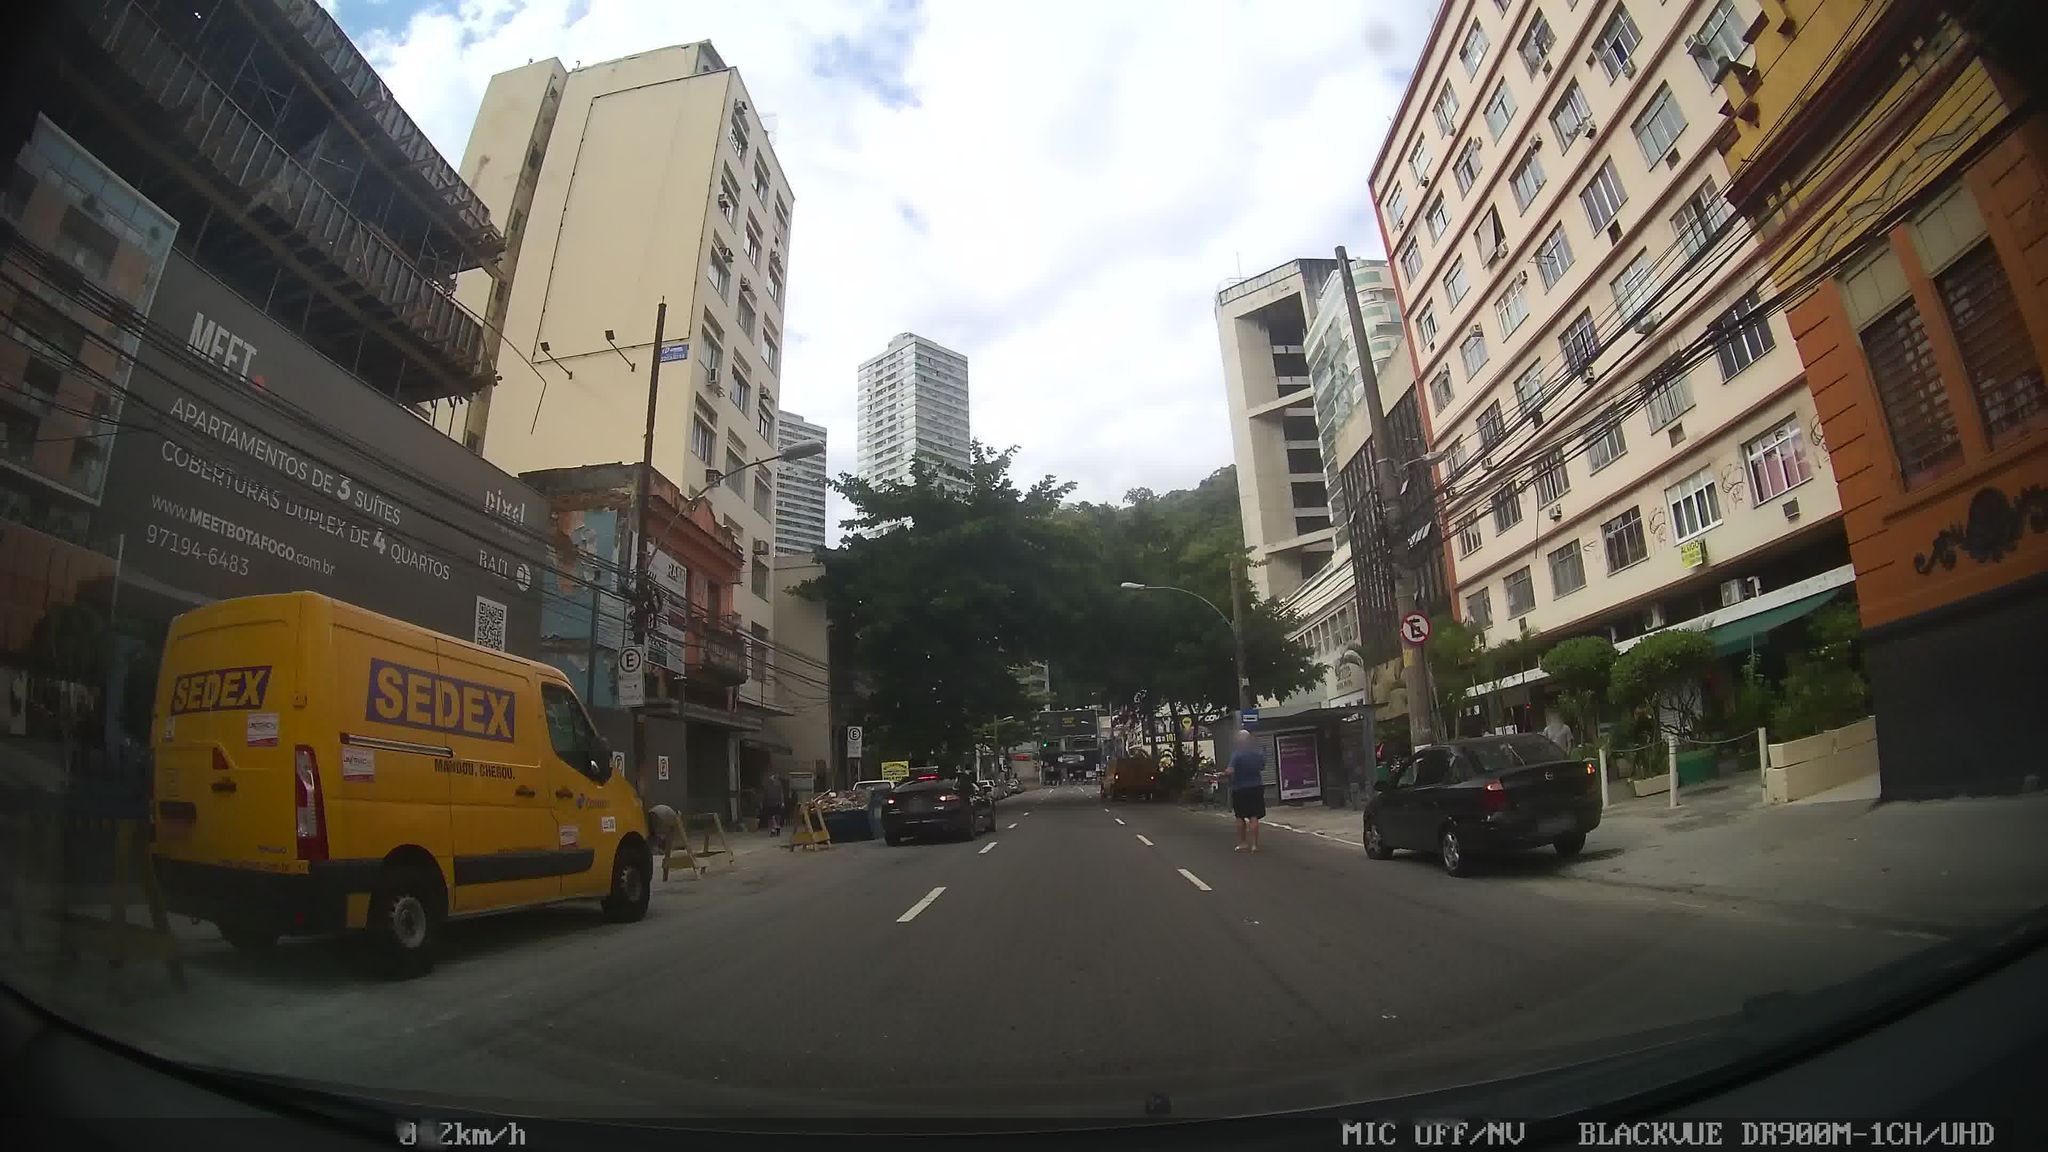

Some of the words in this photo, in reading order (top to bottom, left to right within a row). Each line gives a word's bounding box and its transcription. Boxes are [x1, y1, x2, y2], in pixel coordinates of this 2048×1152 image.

[170, 397, 308, 481] APARTAMENTOS
[312, 469, 334, 493] DE
[151, 494, 336, 577] www.MEETBOTAFOGO.com.br
[162, 440, 280, 510] COBERTURAS
[286, 499, 346, 538] DUPLEX
[350, 525, 370, 549] DE
[373, 527, 387, 554] 4
[390, 543, 450, 580] QUARTOS
[146, 524, 249, 576] 97194-6483
[1408, 618, 1423, 638] E
[174, 669, 267, 712] SEDEX
[626, 653, 635, 667] E
[375, 666, 513, 738] SEDEX
